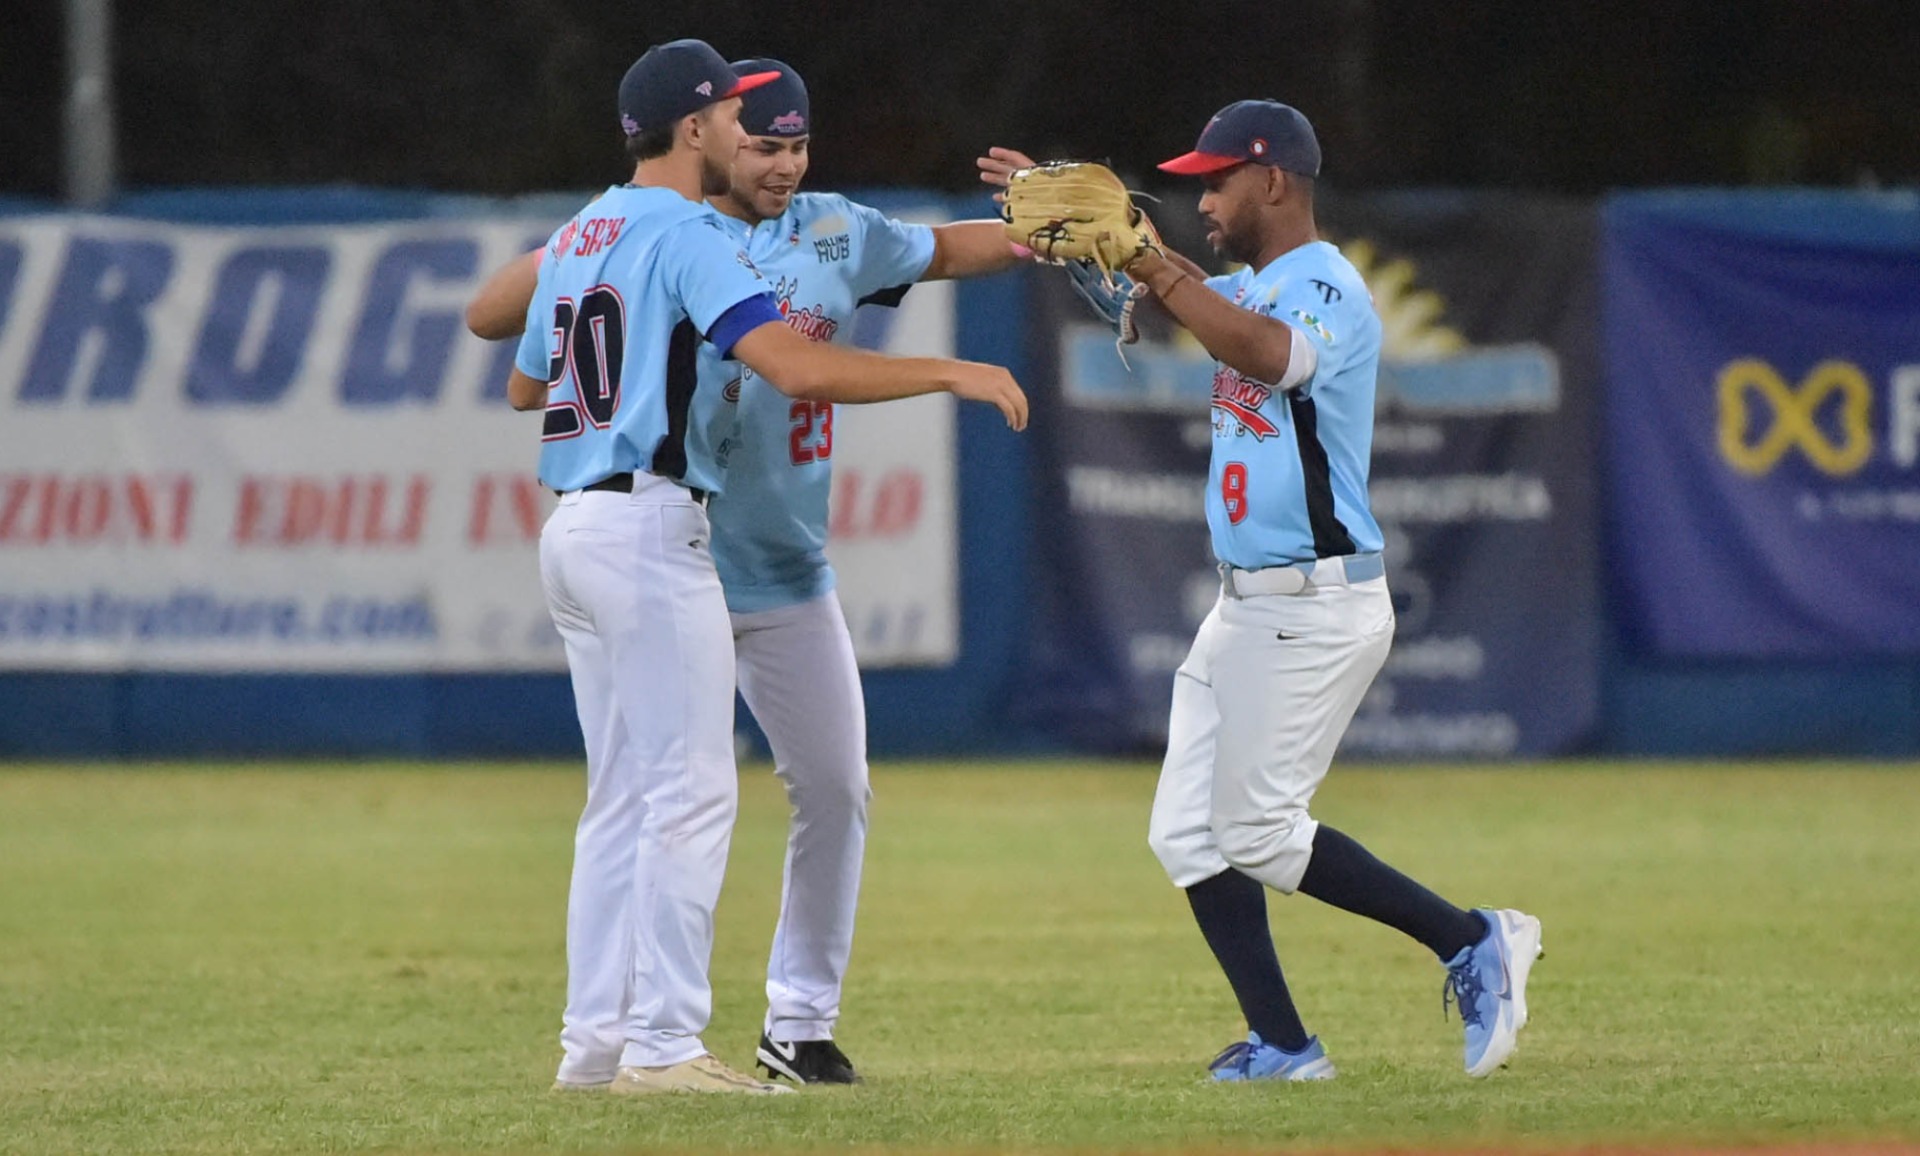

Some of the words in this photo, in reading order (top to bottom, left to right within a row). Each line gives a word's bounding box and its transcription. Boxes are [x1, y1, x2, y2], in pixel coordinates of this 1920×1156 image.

[813, 233, 850, 250] MILLING
[817, 245, 850, 264] HUB
[541, 283, 627, 442] 20
[789, 399, 834, 467] 23
[1221, 461, 1249, 527] 8
